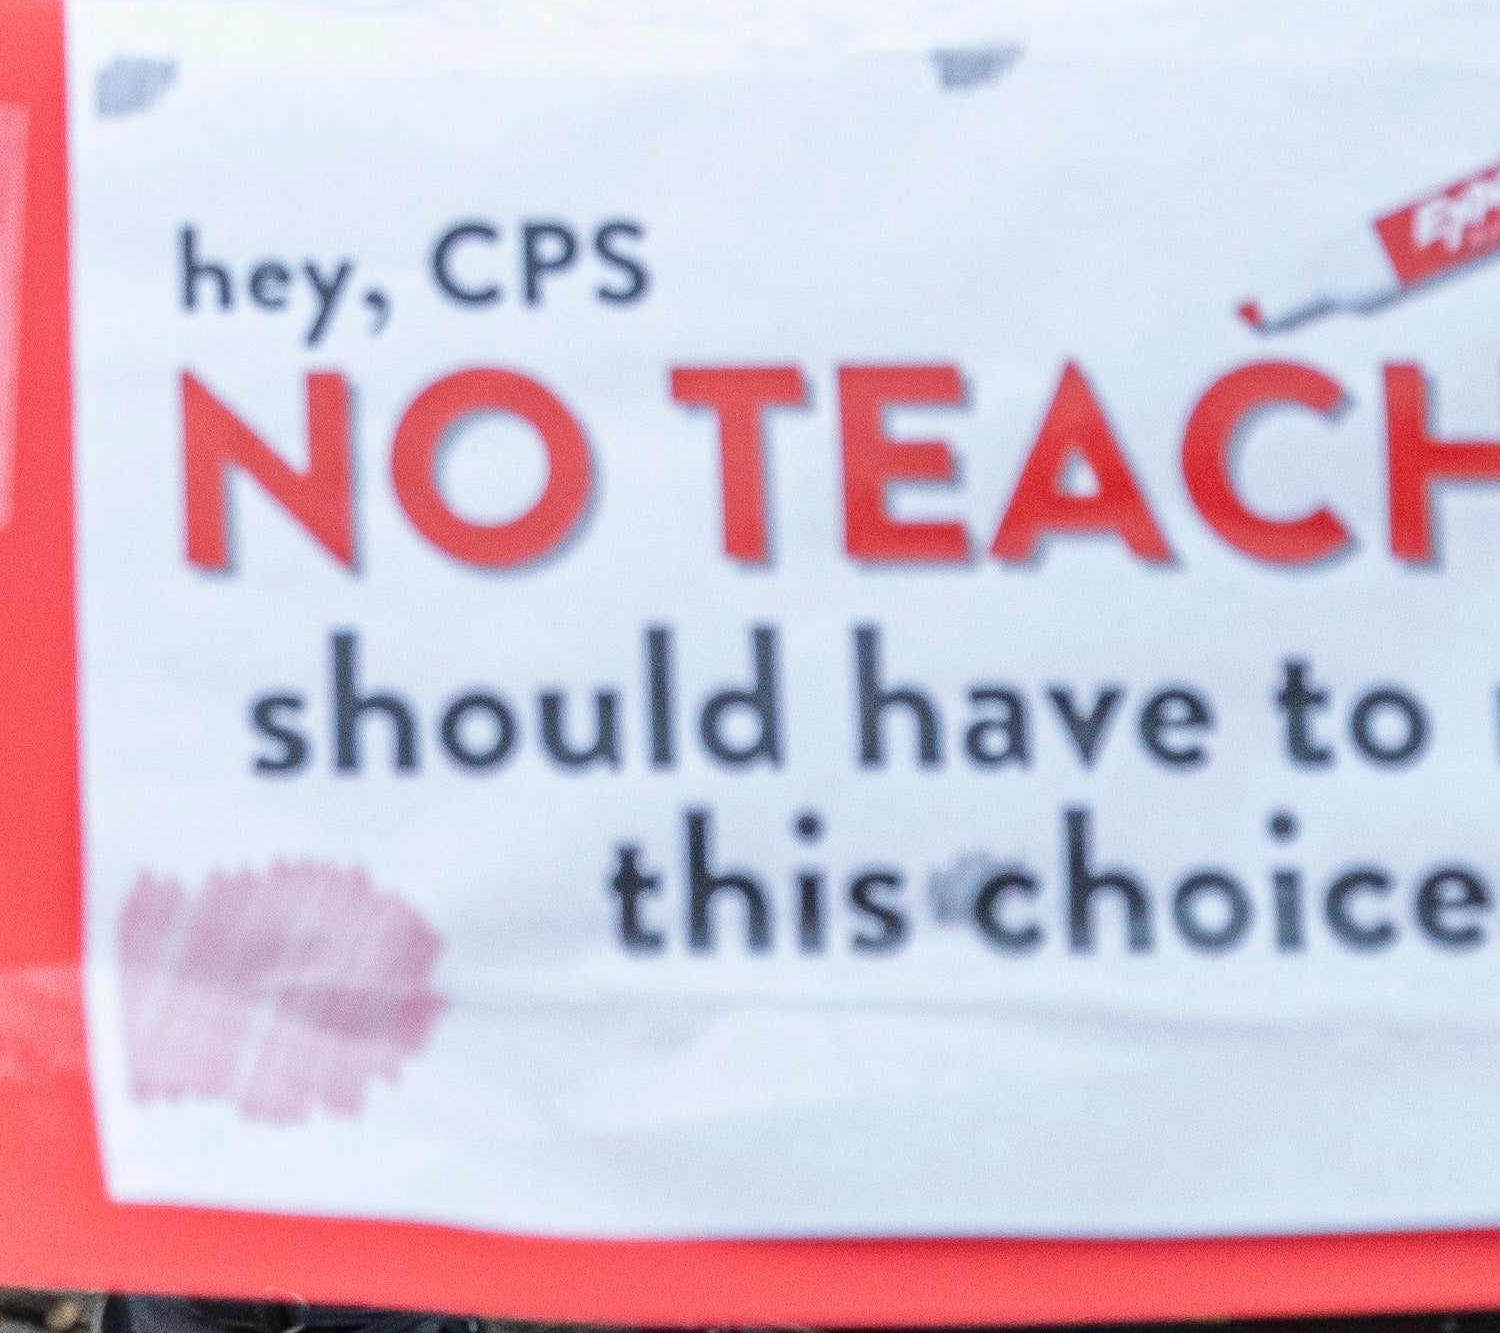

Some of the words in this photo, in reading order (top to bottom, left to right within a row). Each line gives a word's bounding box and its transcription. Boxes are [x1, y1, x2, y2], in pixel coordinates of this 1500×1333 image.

[178, 224, 390, 347] hey,
[429, 219, 651, 309] CPS
[182, 365, 592, 569] NO
[249, 623, 785, 777] should
[852, 624, 1216, 772] have
[1273, 658, 1431, 770] to
[607, 808, 910, 954] this
